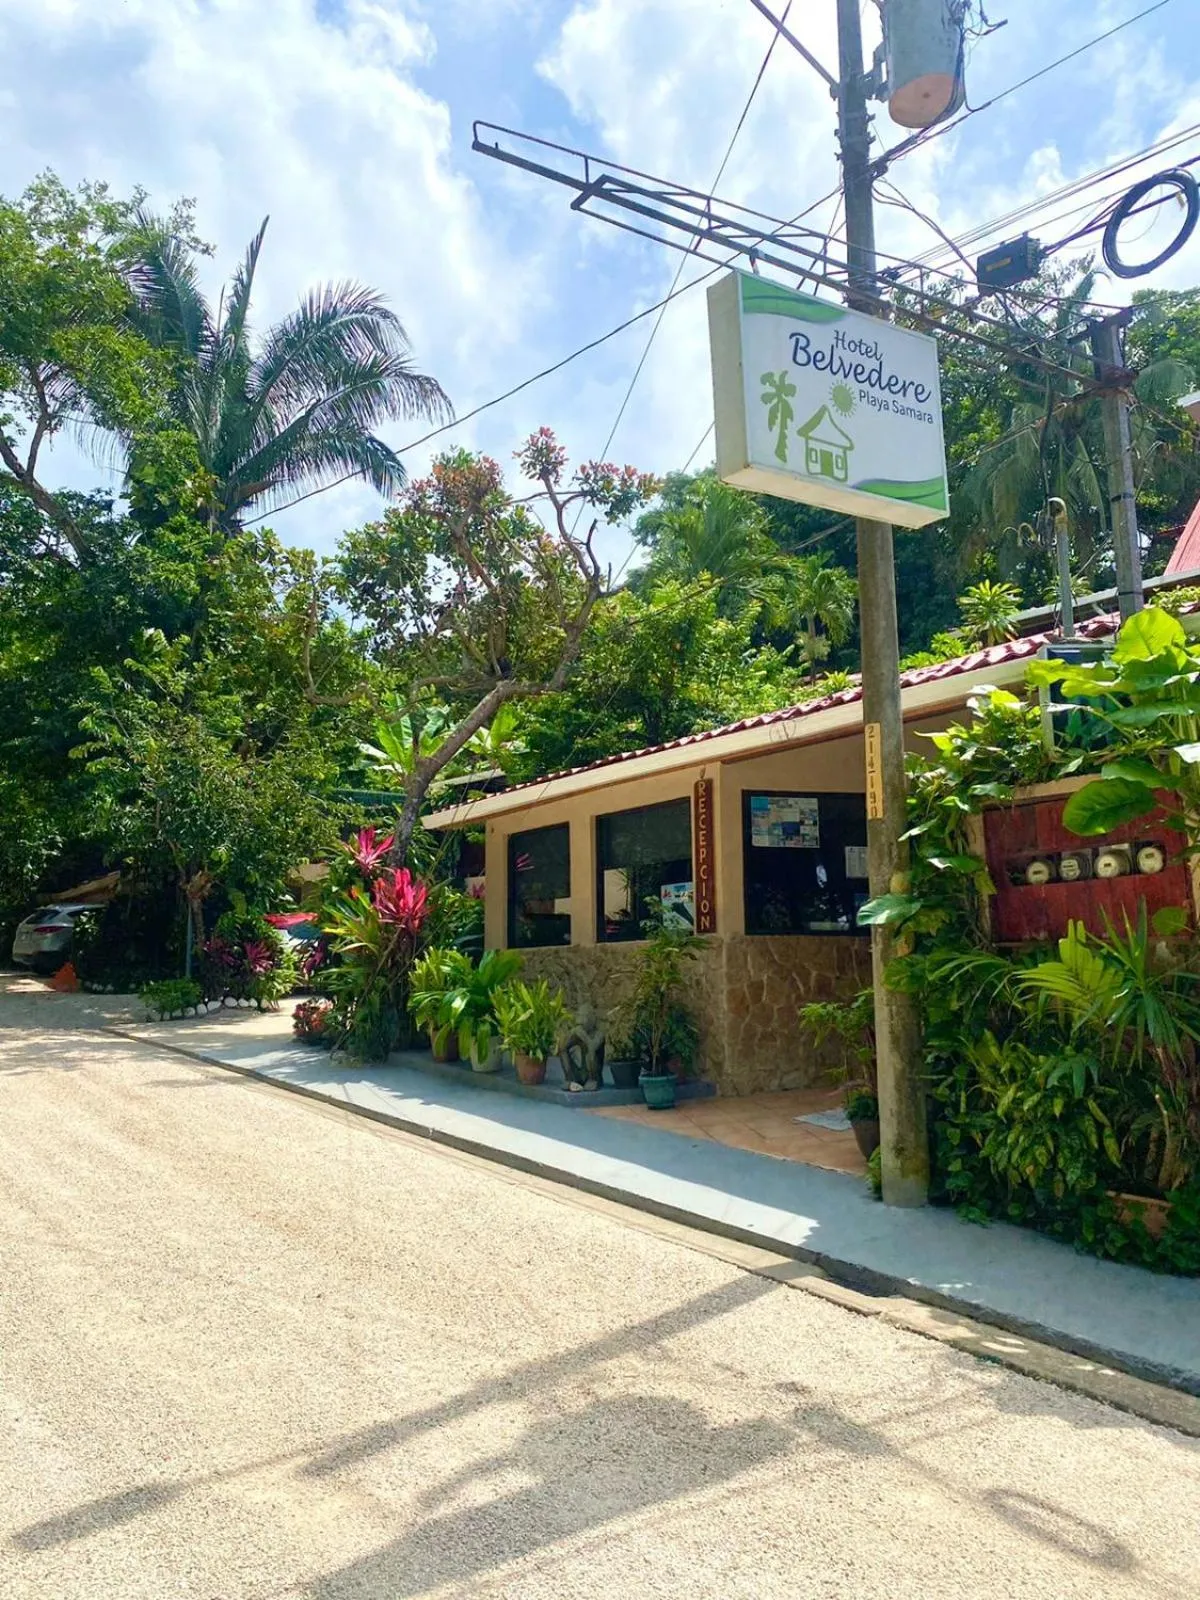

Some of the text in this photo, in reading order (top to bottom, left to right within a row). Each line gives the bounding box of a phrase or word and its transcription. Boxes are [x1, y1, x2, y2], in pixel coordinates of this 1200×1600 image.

[789, 333, 931, 403] Belvedere
[834, 330, 883, 361] Hotel
[859, 390, 933, 424] Playa Samara
[698, 781, 710, 930] RECEPCION
